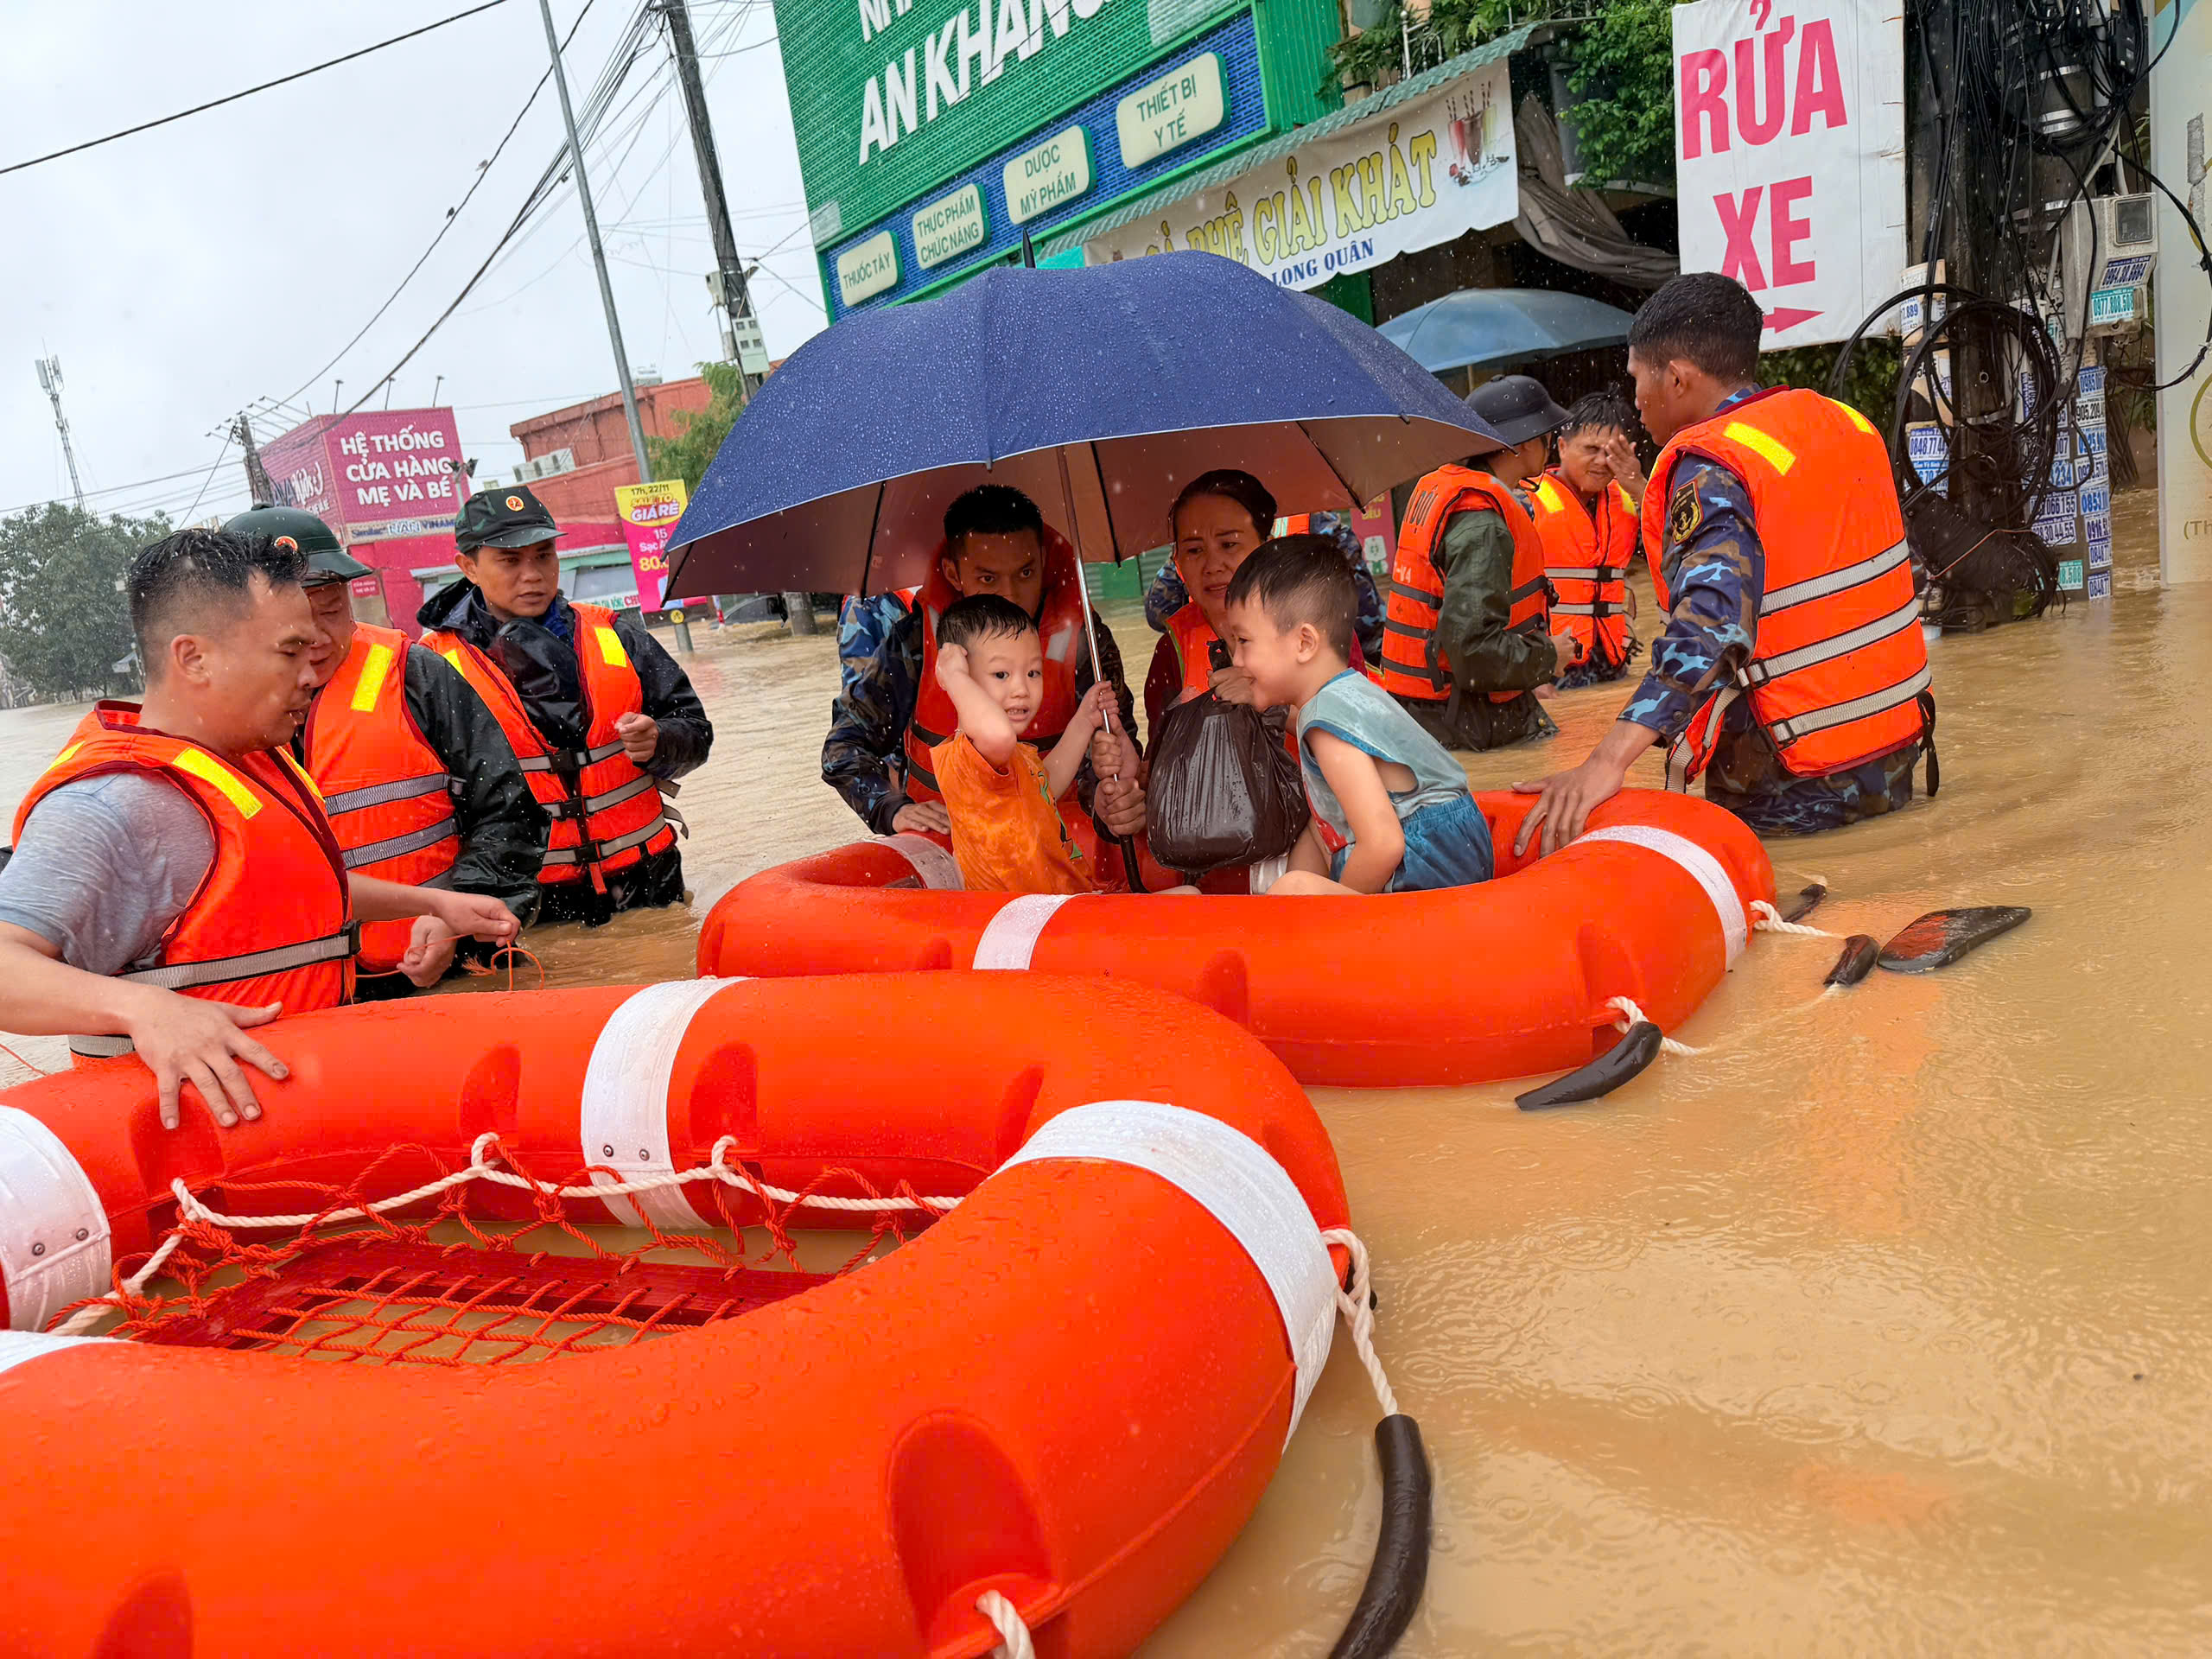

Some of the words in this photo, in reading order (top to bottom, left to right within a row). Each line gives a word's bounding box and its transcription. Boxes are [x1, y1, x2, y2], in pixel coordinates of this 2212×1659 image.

[859, 47, 918, 167] AN
[925, 0, 1104, 123] KHAN
[1136, 81, 1179, 122] THIẾT
[1180, 73, 1198, 103] BỊ
[1680, 0, 1848, 161] RỬA
[1154, 129, 1165, 149] Y
[1166, 107, 1188, 143] TẾ
[1024, 143, 1061, 178] DƯỢC
[1039, 171, 1077, 207] PHẨM
[1253, 155, 1328, 267] GIẢI
[1330, 122, 1437, 239] KHÁT
[917, 211, 945, 238] THỰC
[944, 194, 976, 226] PHẨM
[1712, 175, 1816, 293] XE
[920, 235, 950, 264] CHỨC
[1271, 257, 1319, 290] LONG
[1324, 237, 1375, 272] QUÂN
[842, 261, 872, 289] THUỐC
[340, 430, 370, 458] HỆ
[370, 423, 446, 454] THỐNG
[346, 457, 392, 483] CỬA
[393, 454, 454, 479] HÀNG
[356, 485, 391, 508] MẸ
[393, 478, 424, 502] VÀ
[426, 475, 453, 499] BÉ
[631, 505, 658, 522] GIÁ
